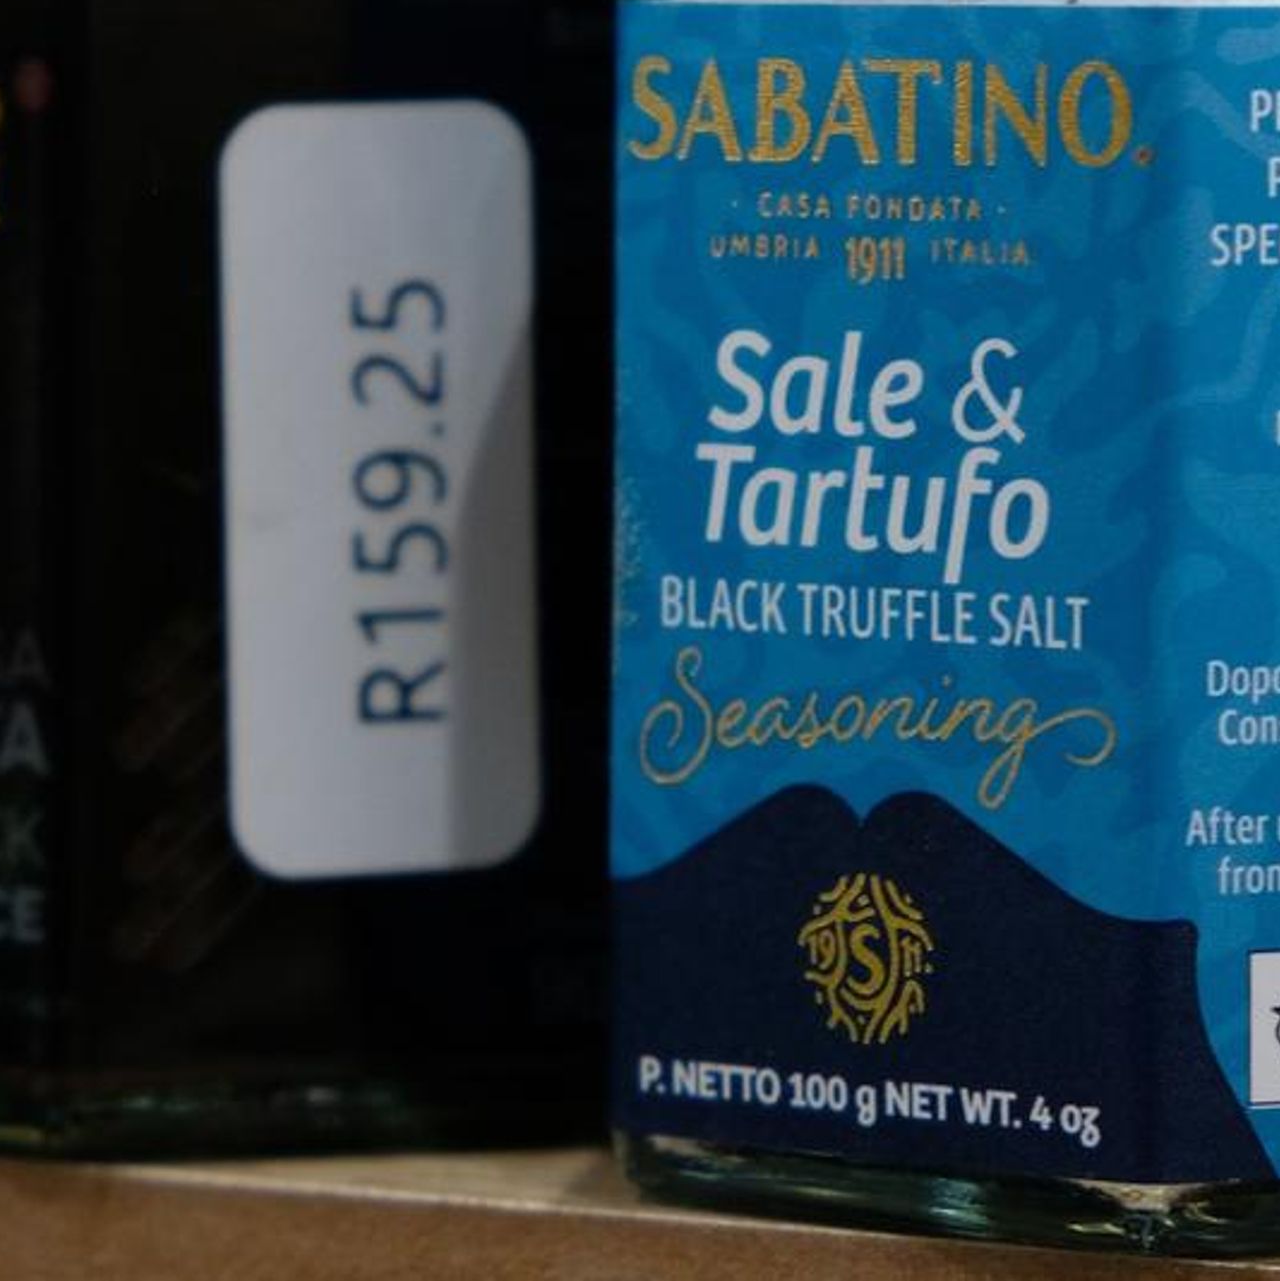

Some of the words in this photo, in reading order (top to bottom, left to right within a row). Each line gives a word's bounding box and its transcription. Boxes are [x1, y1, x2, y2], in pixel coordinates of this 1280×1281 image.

[757, 191, 830, 219] CASA
[846, 194, 982, 222] FONDATA
[709, 233, 819, 260] UMBRIA
[845, 235, 907, 284] 1911
[931, 239, 1032, 266] ITALIA
[707, 329, 924, 439] Sale
[951, 337, 1027, 444] &
[349, 276, 449, 726] R159.25
[696, 442, 1051, 585] Tartufo
[660, 574, 787, 635] BLACK
[797, 582, 976, 645] TRUFFLE
[988, 592, 1089, 650] SALT
[639, 645, 1117, 810] Seasoning
[1186, 808, 1265, 847] After
[639, 1056, 666, 1094] P.
[672, 1061, 781, 1104] NETTO
[787, 1072, 849, 1110] 100
[855, 1083, 877, 1126] g
[884, 1081, 953, 1122] NET
[960, 1089, 1022, 1129] WT.
[1029, 1097, 1052, 1131] 4
